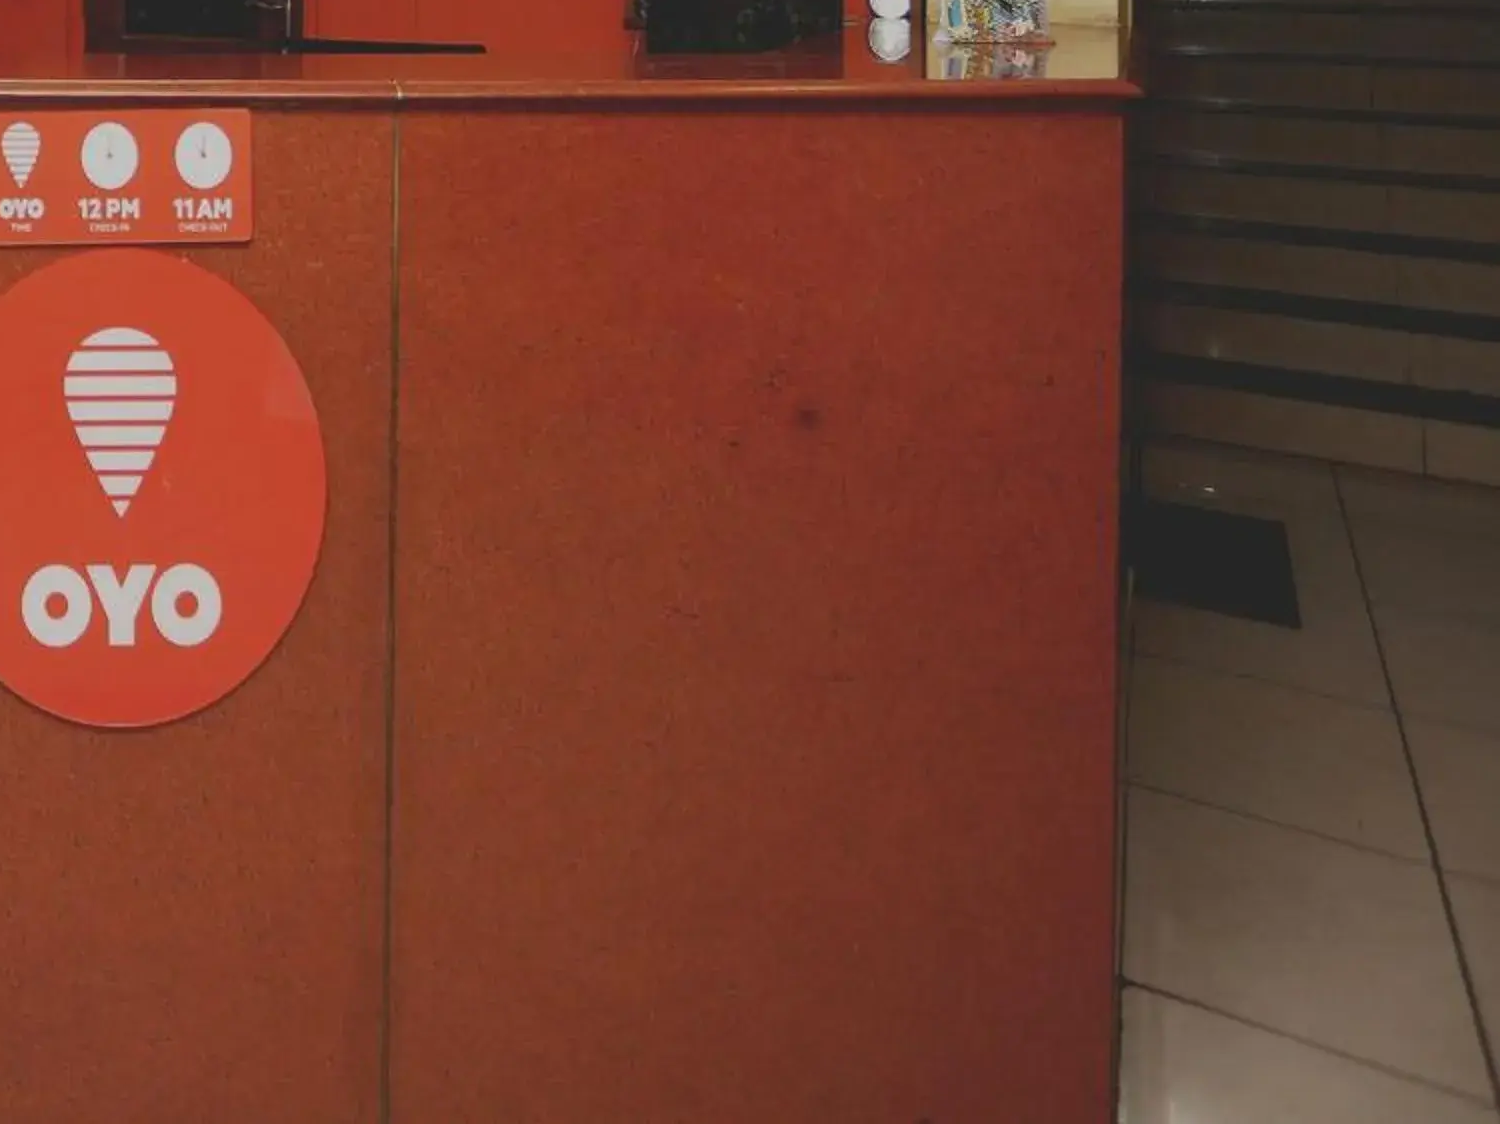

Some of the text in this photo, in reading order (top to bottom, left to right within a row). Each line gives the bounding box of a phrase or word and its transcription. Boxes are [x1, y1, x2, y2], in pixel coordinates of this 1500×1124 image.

[77, 198, 140, 220] 12 PM
[172, 197, 233, 220] 11 AM
[21, 563, 222, 648] OYO
